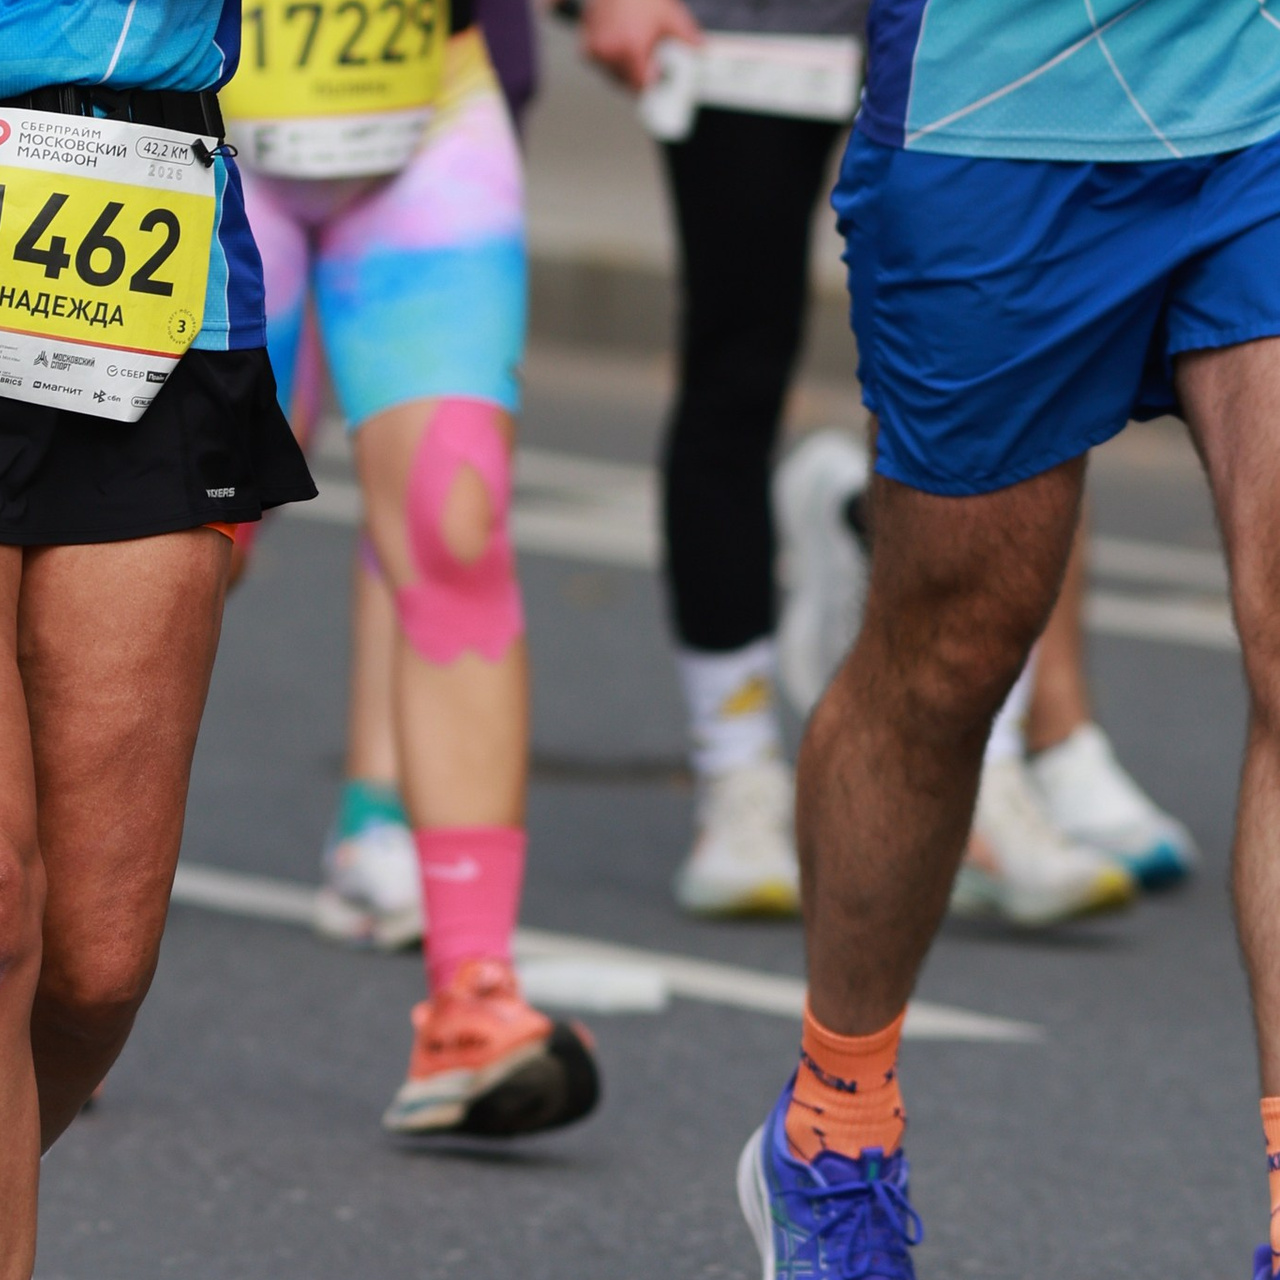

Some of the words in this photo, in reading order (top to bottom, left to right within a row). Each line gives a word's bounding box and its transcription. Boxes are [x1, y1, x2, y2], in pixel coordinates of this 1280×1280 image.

[21, 121, 101, 139] СБЕРПРАЙМ
[19, 132, 127, 158] МОСКОВСКИЙ
[143, 141, 169, 157] 42,2
[17, 146, 98, 168] МАРАФОН
[177, 320, 186, 333] 3
[50, 361, 71, 372] СПОРТ
[52, 352, 96, 368] МОСКОВСКИЙ
[120, 368, 145, 379] СБЕР
[0, 377, 22, 387] BRICS
[41, 382, 83, 396] магнит
[107, 395, 121, 403] сбп
